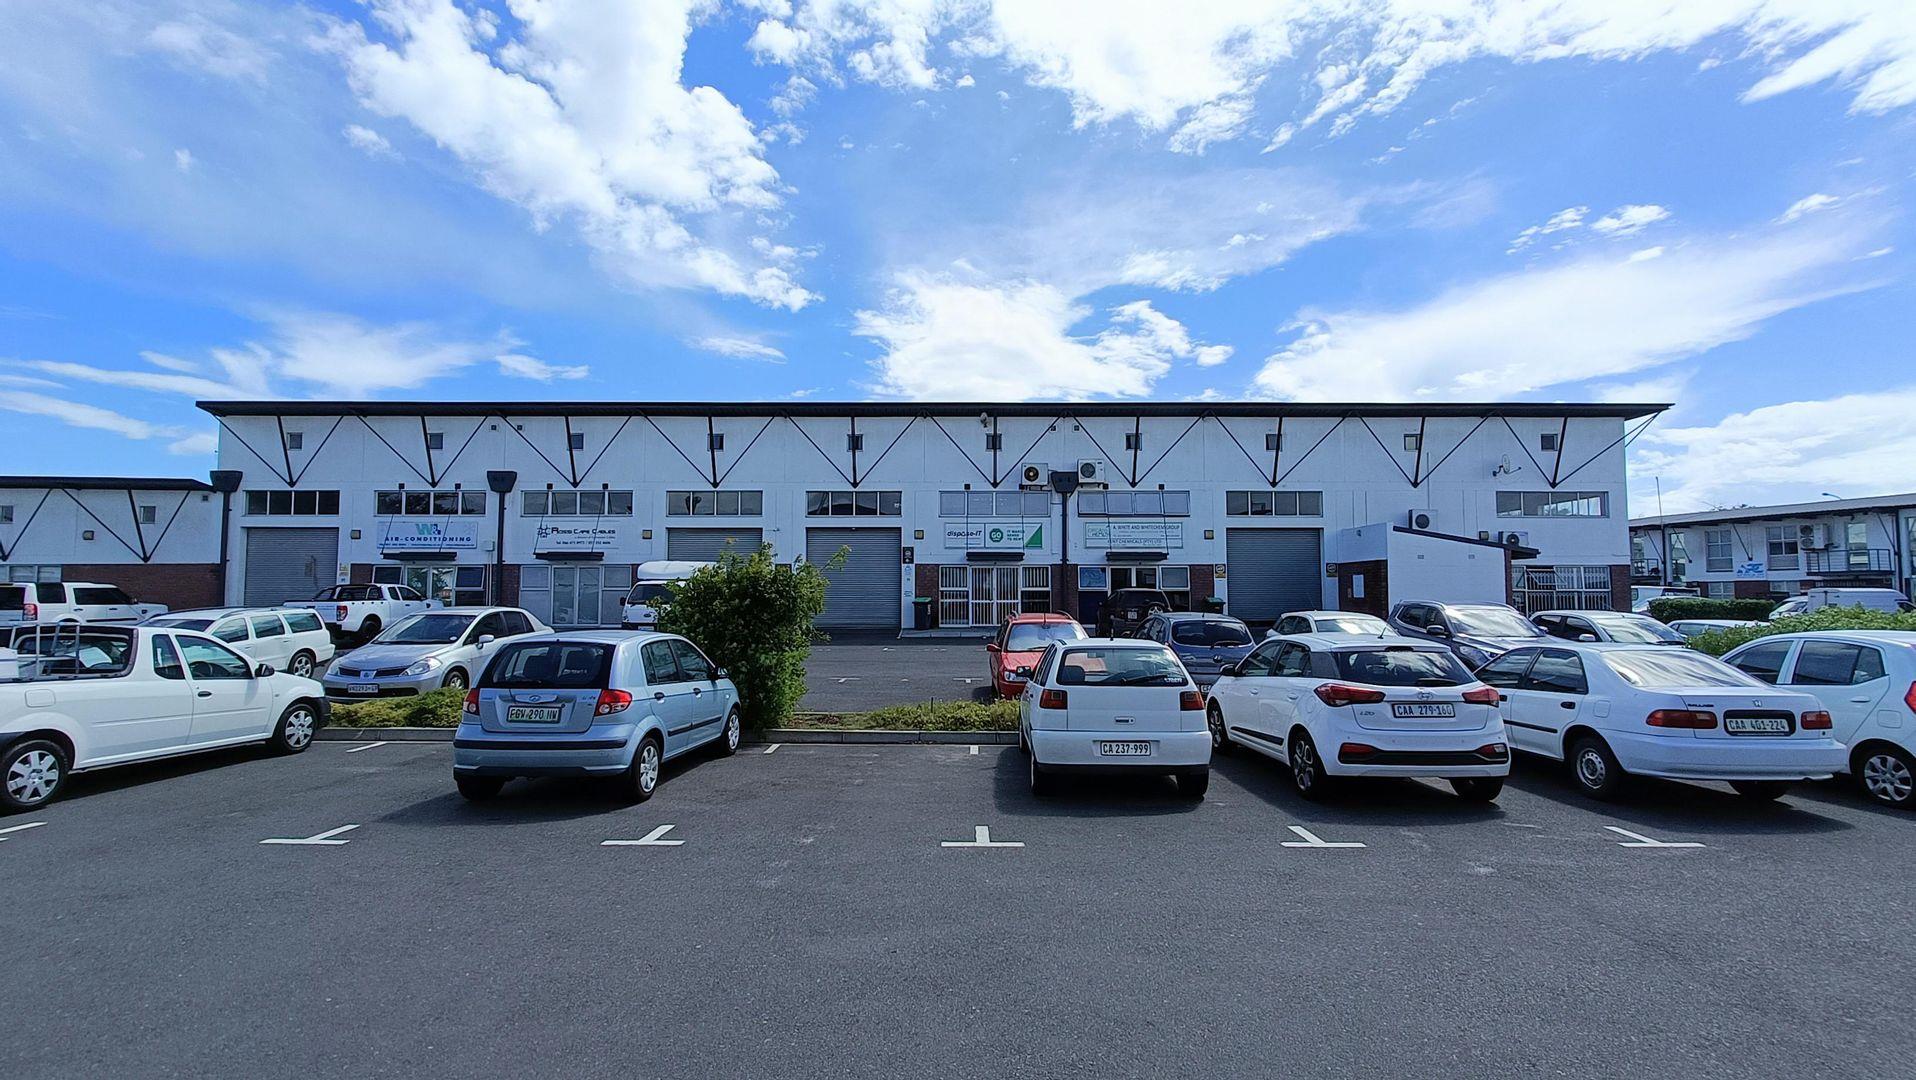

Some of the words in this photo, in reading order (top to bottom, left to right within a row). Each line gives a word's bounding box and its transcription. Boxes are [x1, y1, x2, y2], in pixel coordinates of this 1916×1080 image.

[509, 708, 526, 719] FGW
[529, 709, 544, 719] 290
[1397, 705, 1414, 716] CAA
[1419, 705, 1452, 716] 279-160
[1729, 720, 1746, 730] CAA
[1750, 720, 1786, 730] 401-224
[1103, 744, 1114, 754] CA
[1116, 744, 1149, 754] 237-999
